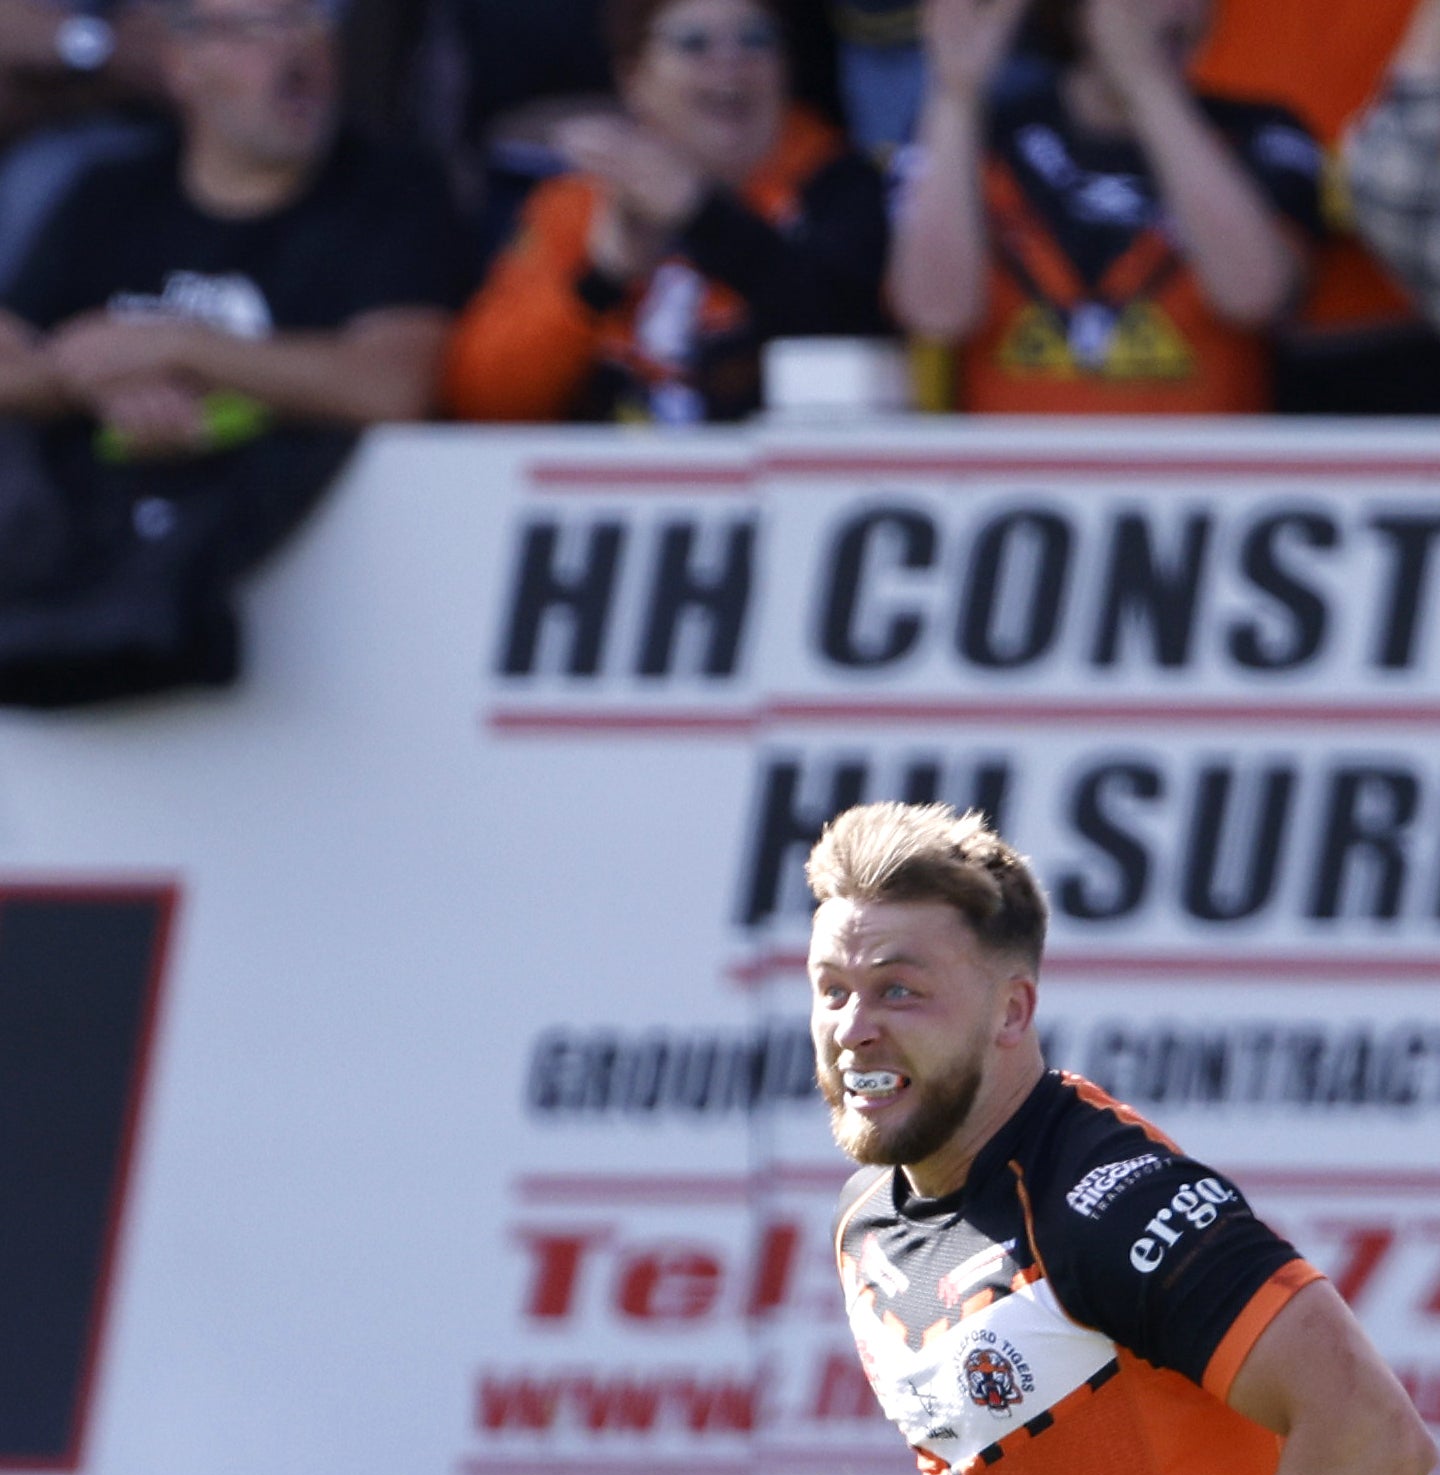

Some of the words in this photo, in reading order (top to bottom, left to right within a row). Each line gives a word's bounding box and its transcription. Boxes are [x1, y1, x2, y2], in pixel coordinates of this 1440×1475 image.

[496, 518, 758, 678] HH
[1129, 1177, 1230, 1274] ergo
[1001, 1340, 1036, 1393] TIGERS
